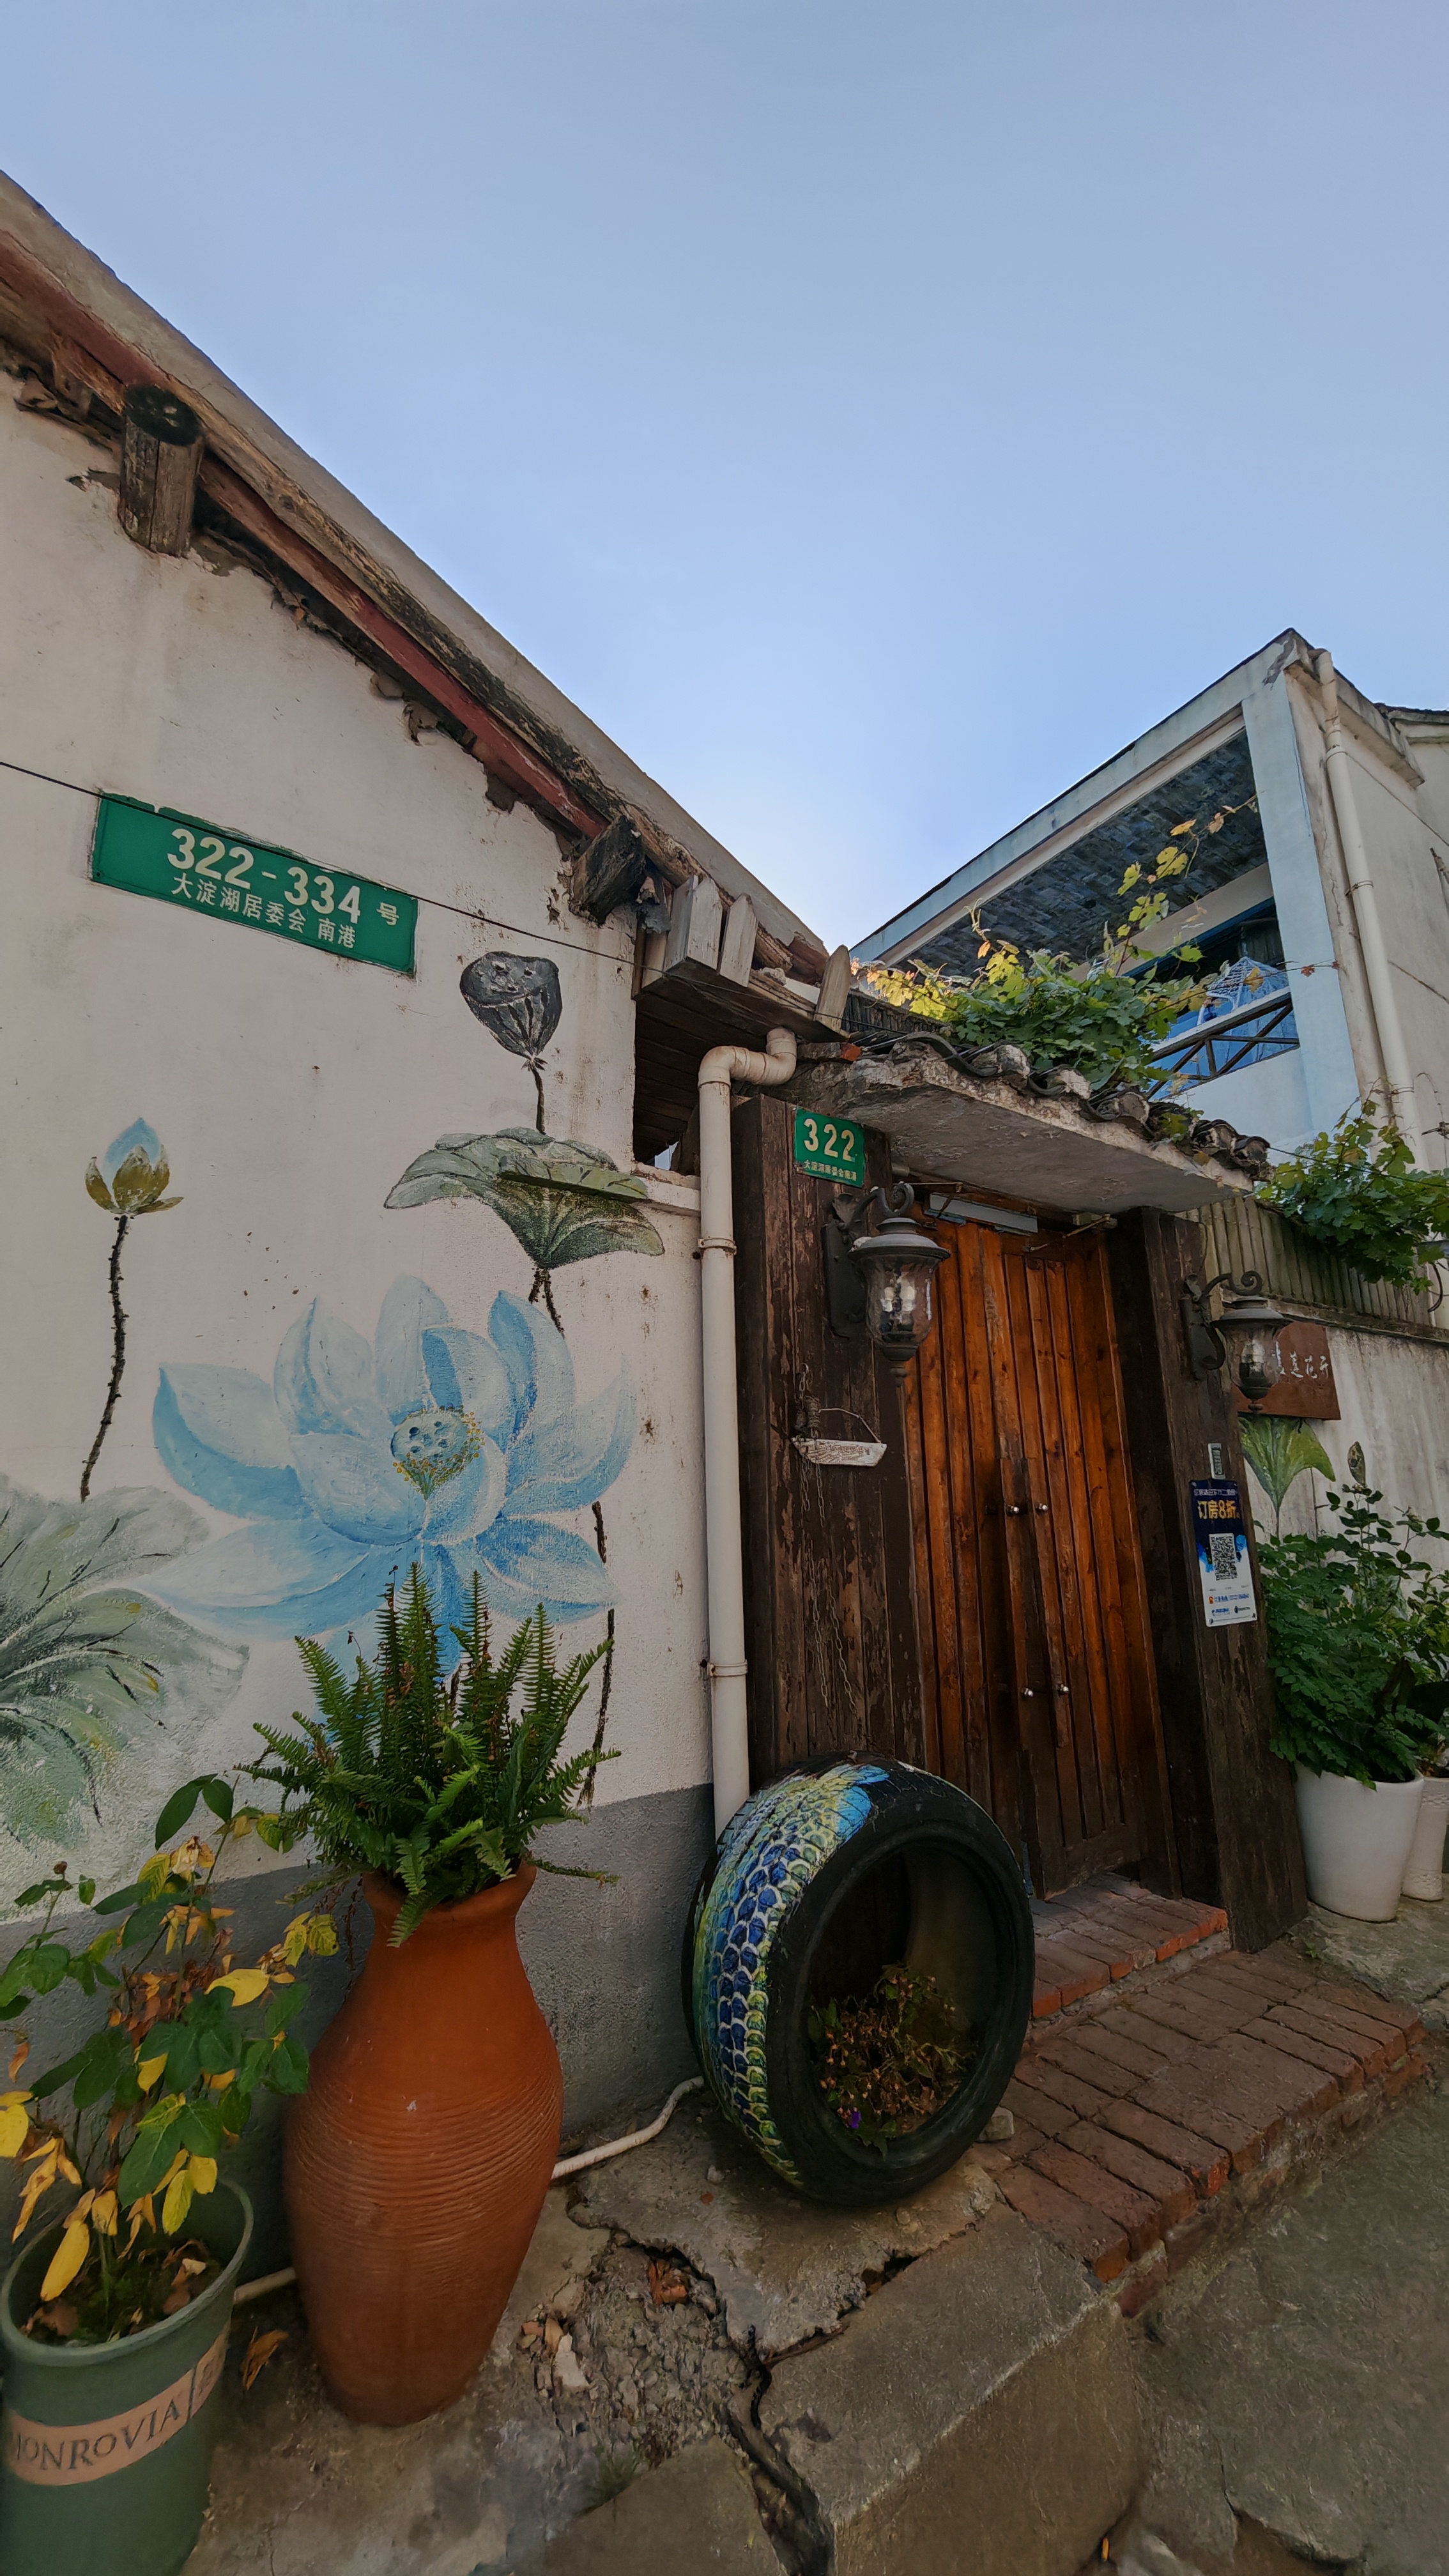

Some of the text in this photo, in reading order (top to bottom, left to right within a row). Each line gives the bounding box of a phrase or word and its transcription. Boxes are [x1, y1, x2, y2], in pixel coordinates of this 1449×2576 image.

[167, 828, 400, 926] 322-334 号
[171, 872, 356, 949] 大淀湖居委会 南港
[804, 1118, 855, 1162] 322
